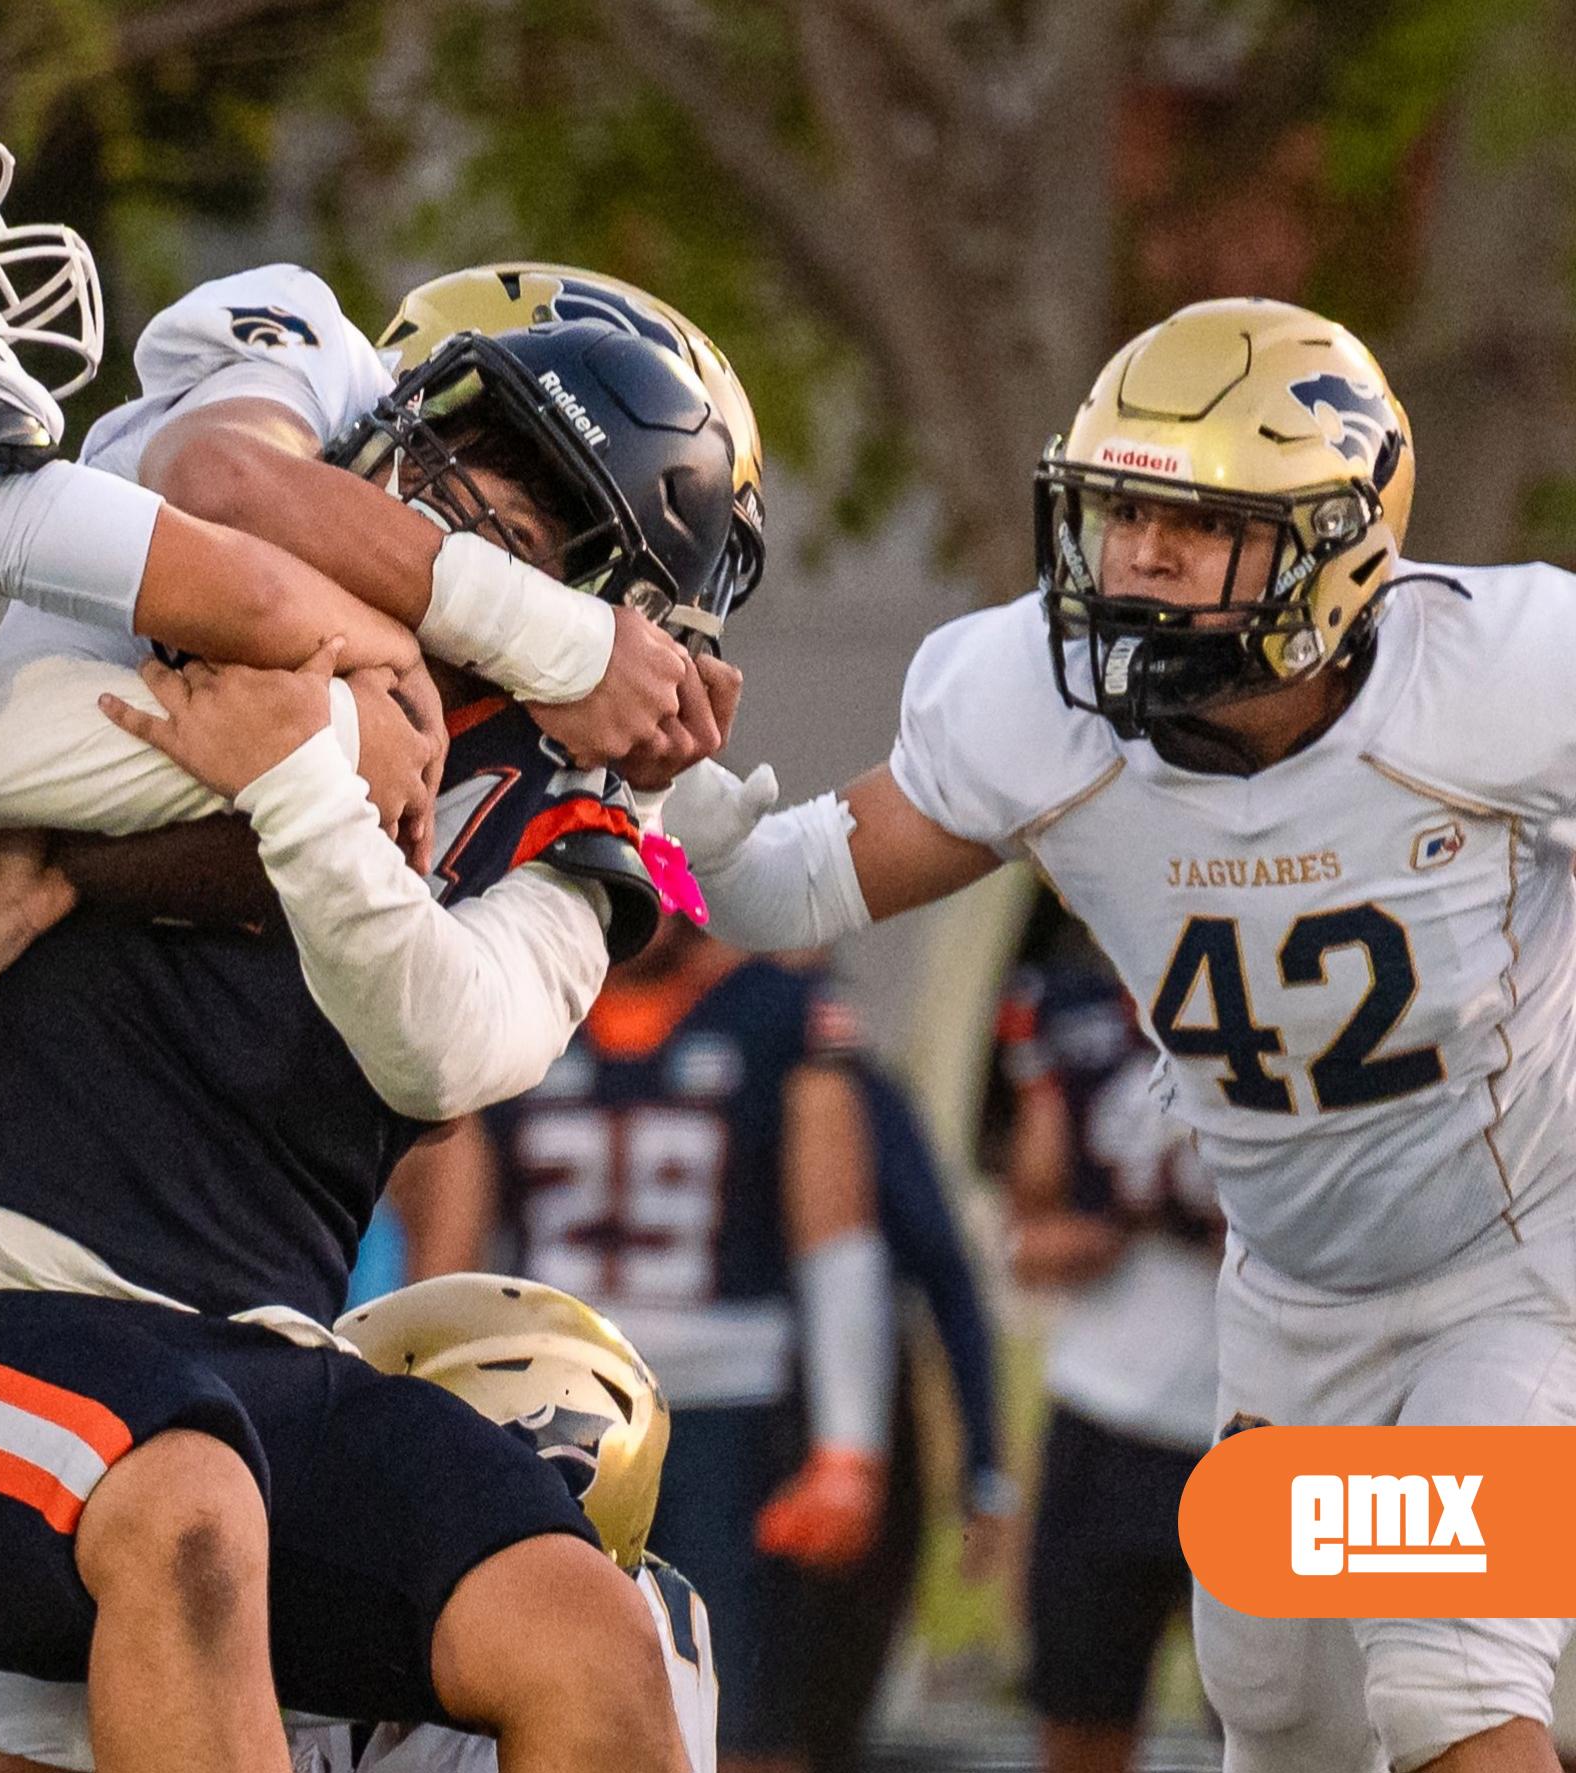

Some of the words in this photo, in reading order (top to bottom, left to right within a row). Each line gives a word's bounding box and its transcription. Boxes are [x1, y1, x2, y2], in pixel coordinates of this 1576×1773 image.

[538, 370, 607, 446] Riddell
[1102, 447, 1178, 474] Riddell
[1166, 848, 1342, 889] JAGUARES
[1149, 900, 1449, 1116] 42
